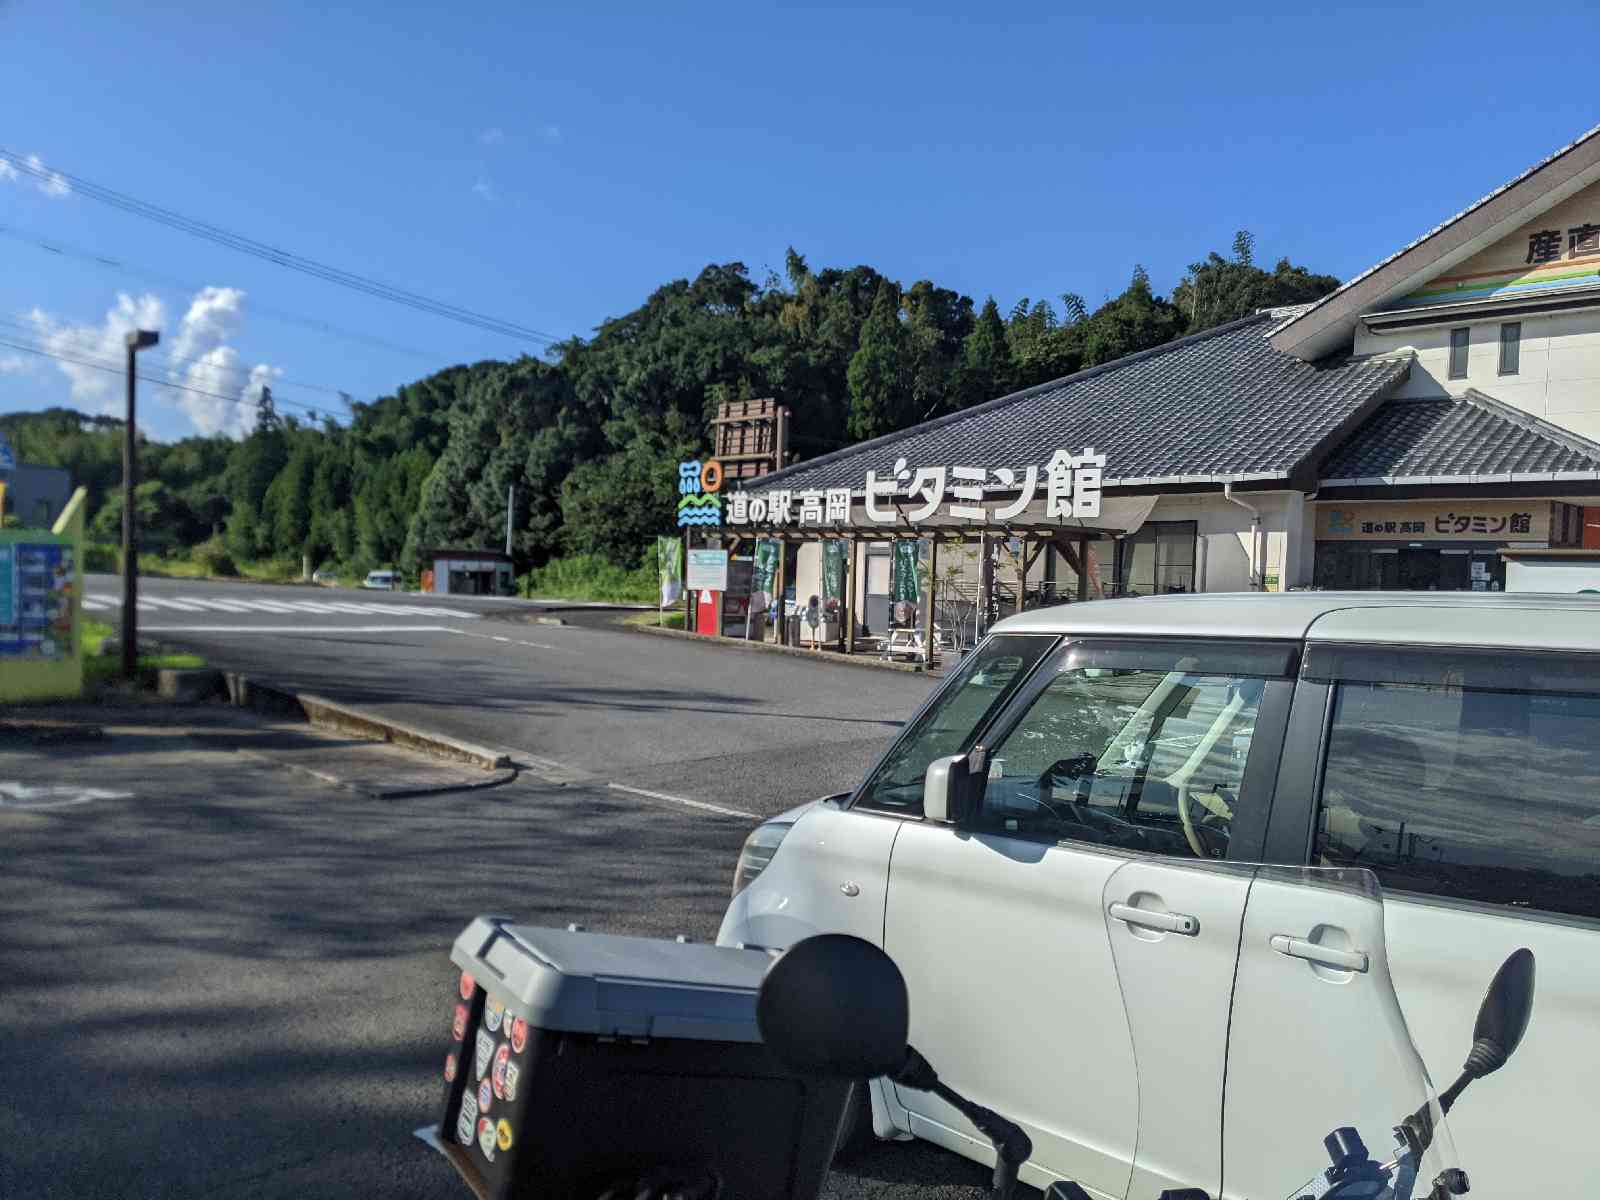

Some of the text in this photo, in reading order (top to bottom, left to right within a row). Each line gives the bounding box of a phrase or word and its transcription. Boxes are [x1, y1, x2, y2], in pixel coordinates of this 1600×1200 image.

[865, 448, 1106, 522] ビタミン館
[1434, 512, 1532, 533] ビタミン館
